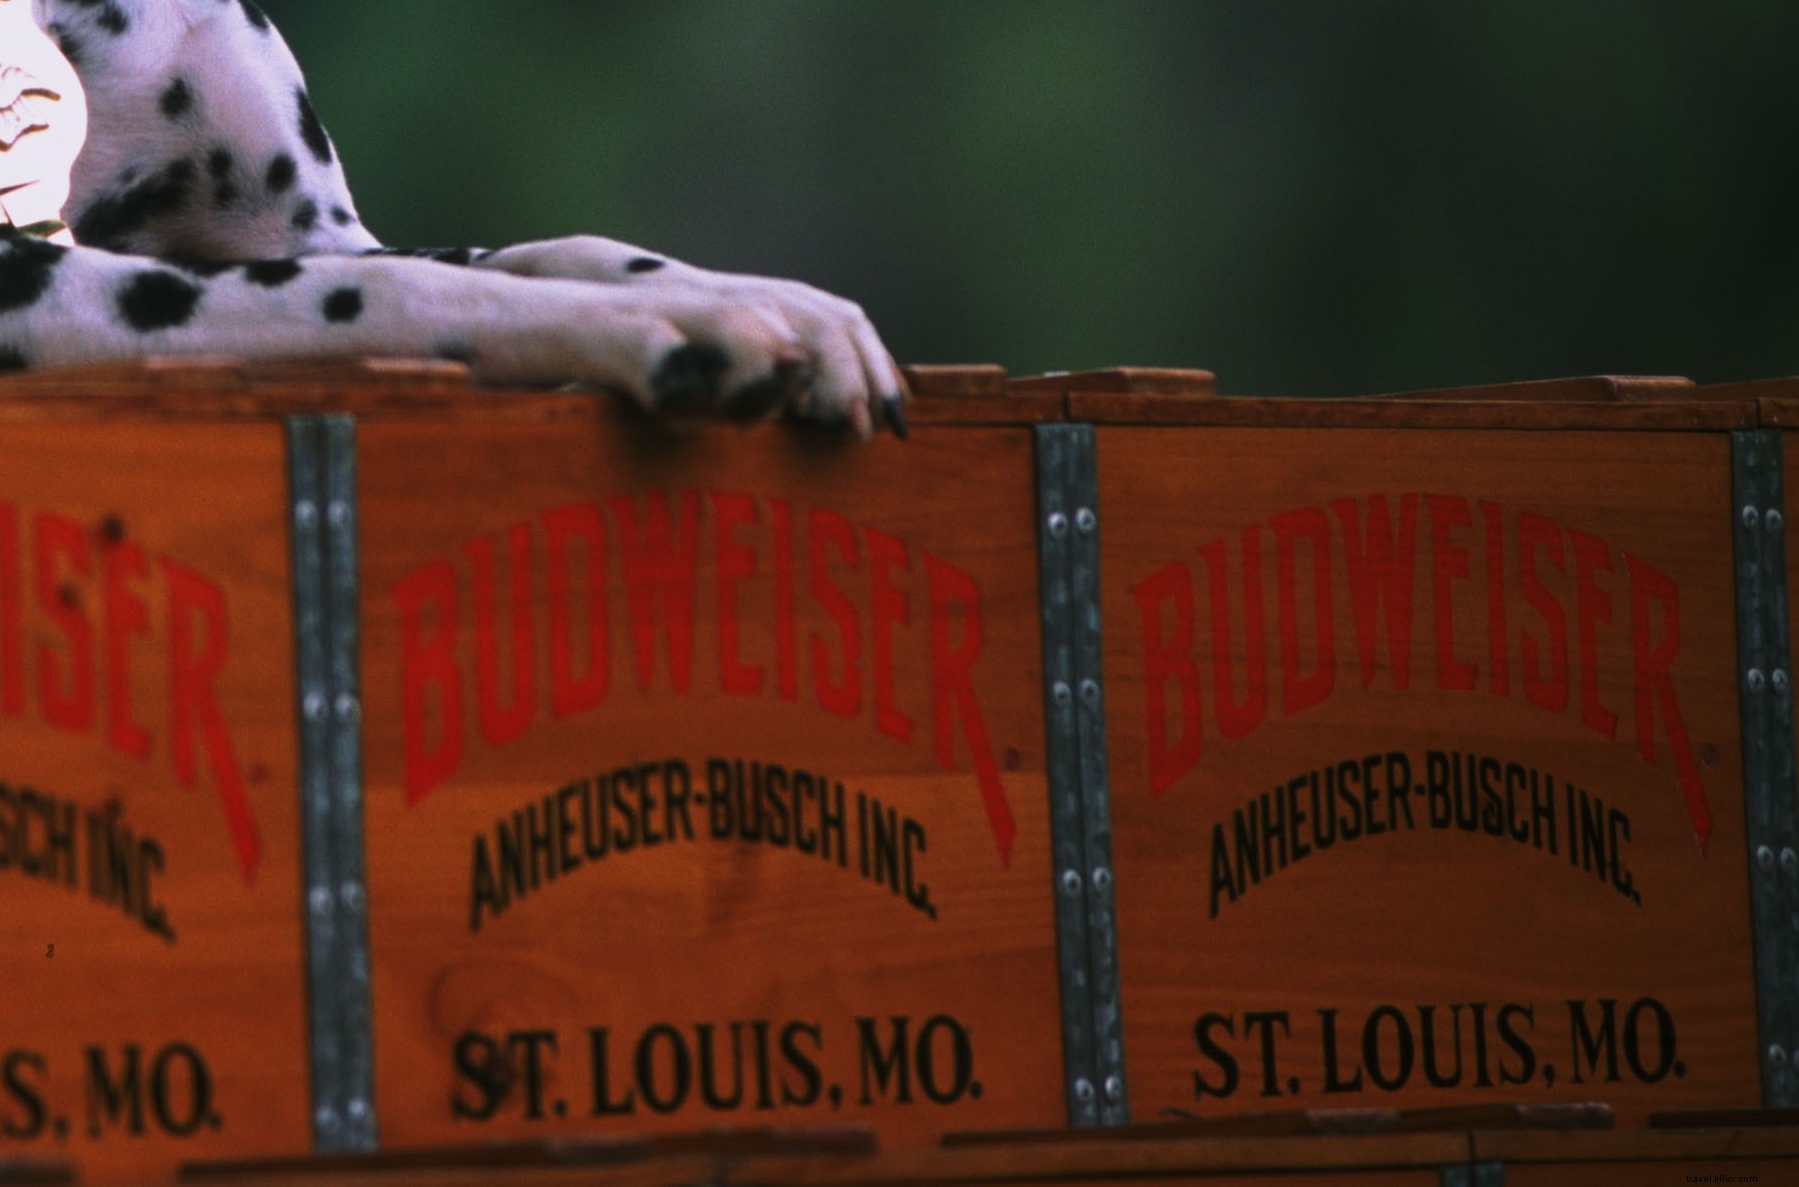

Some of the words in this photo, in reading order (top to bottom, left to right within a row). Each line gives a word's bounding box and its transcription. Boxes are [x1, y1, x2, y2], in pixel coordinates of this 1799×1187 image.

[389, 489, 1016, 870] BUDWEISER
[1130, 492, 1713, 861] BUDWEISER
[468, 757, 849, 933] ANHEUSER-BUSCH
[1207, 750, 1558, 920] ANHEUSER-BUSCH
[82, 1040, 223, 1138] MO.
[449, 1027, 567, 1122] ST.
[585, 1019, 843, 1116] LOUIS,
[855, 1013, 983, 1107] MO.
[1193, 1010, 1301, 1100] ST.
[1316, 1001, 1555, 1093] LOUIS,
[1565, 996, 1686, 1085] MO.
